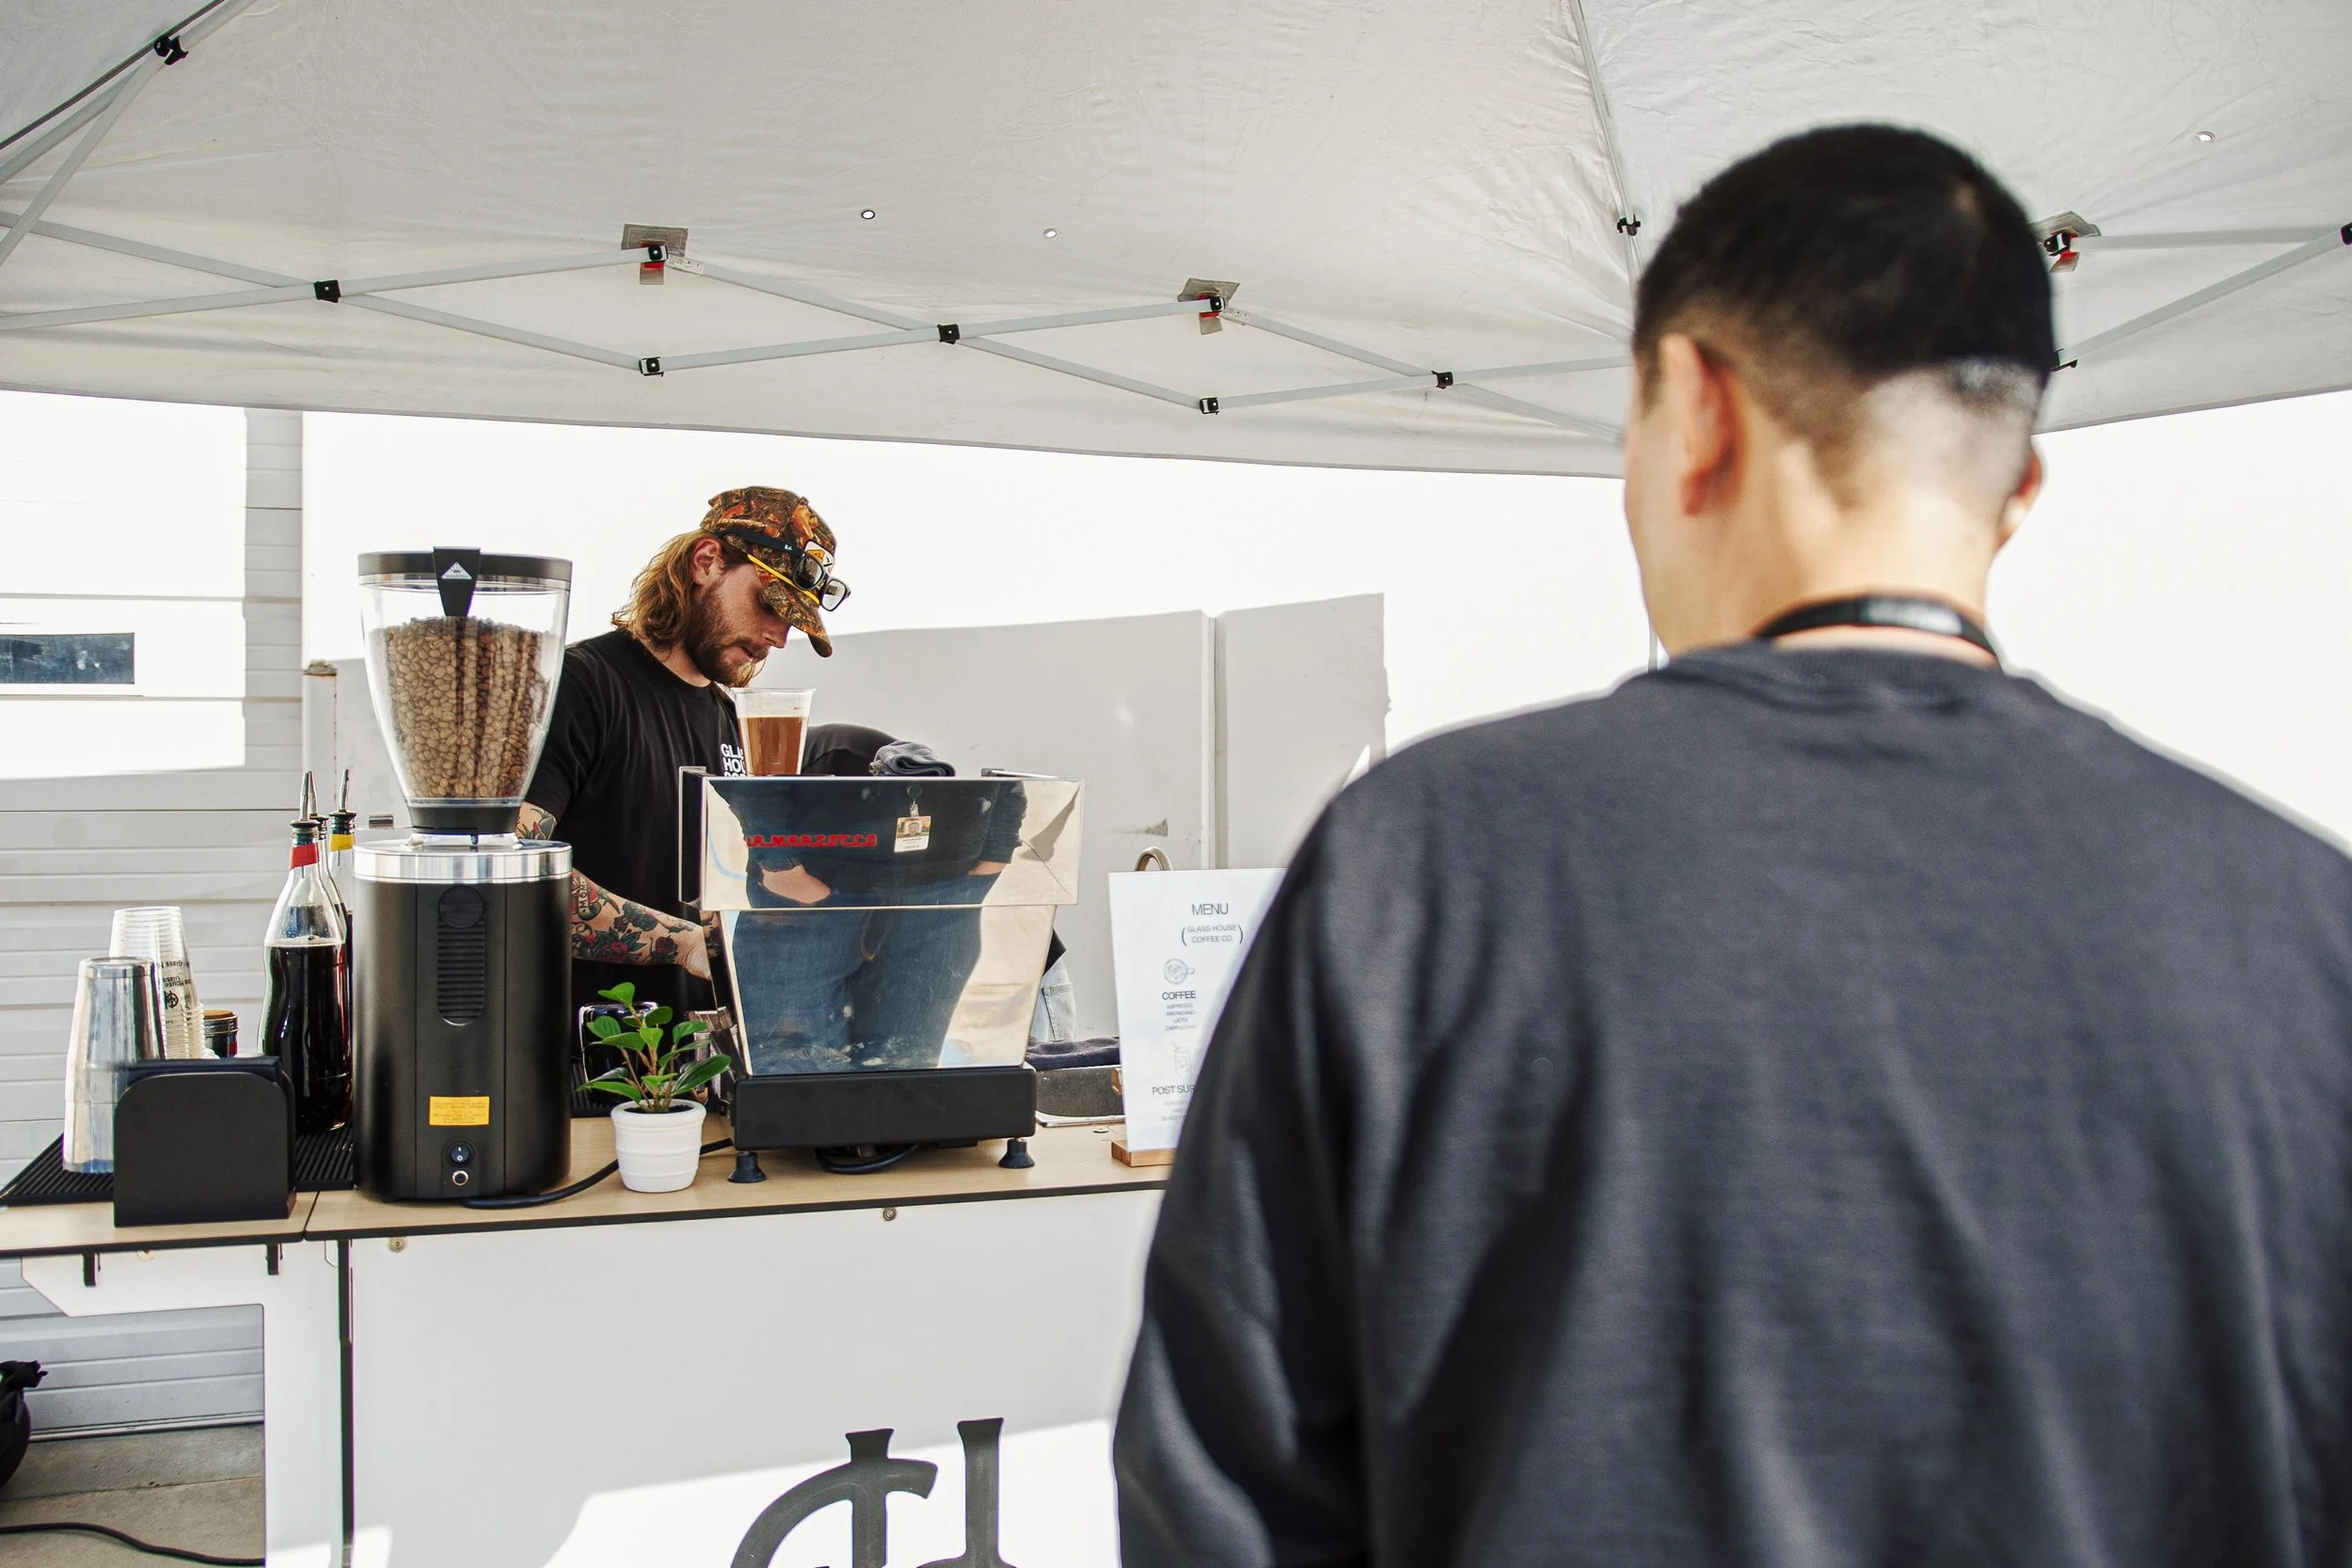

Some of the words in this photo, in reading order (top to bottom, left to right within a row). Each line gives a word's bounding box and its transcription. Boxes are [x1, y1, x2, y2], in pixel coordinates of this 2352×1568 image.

[1192, 903, 1229, 915] MENU
[1191, 935, 1219, 943] COFFEE
[1162, 990, 1197, 1000] COFFEE
[1152, 1085, 1175, 1095] POST
[1177, 1084, 1196, 1093] SUR
